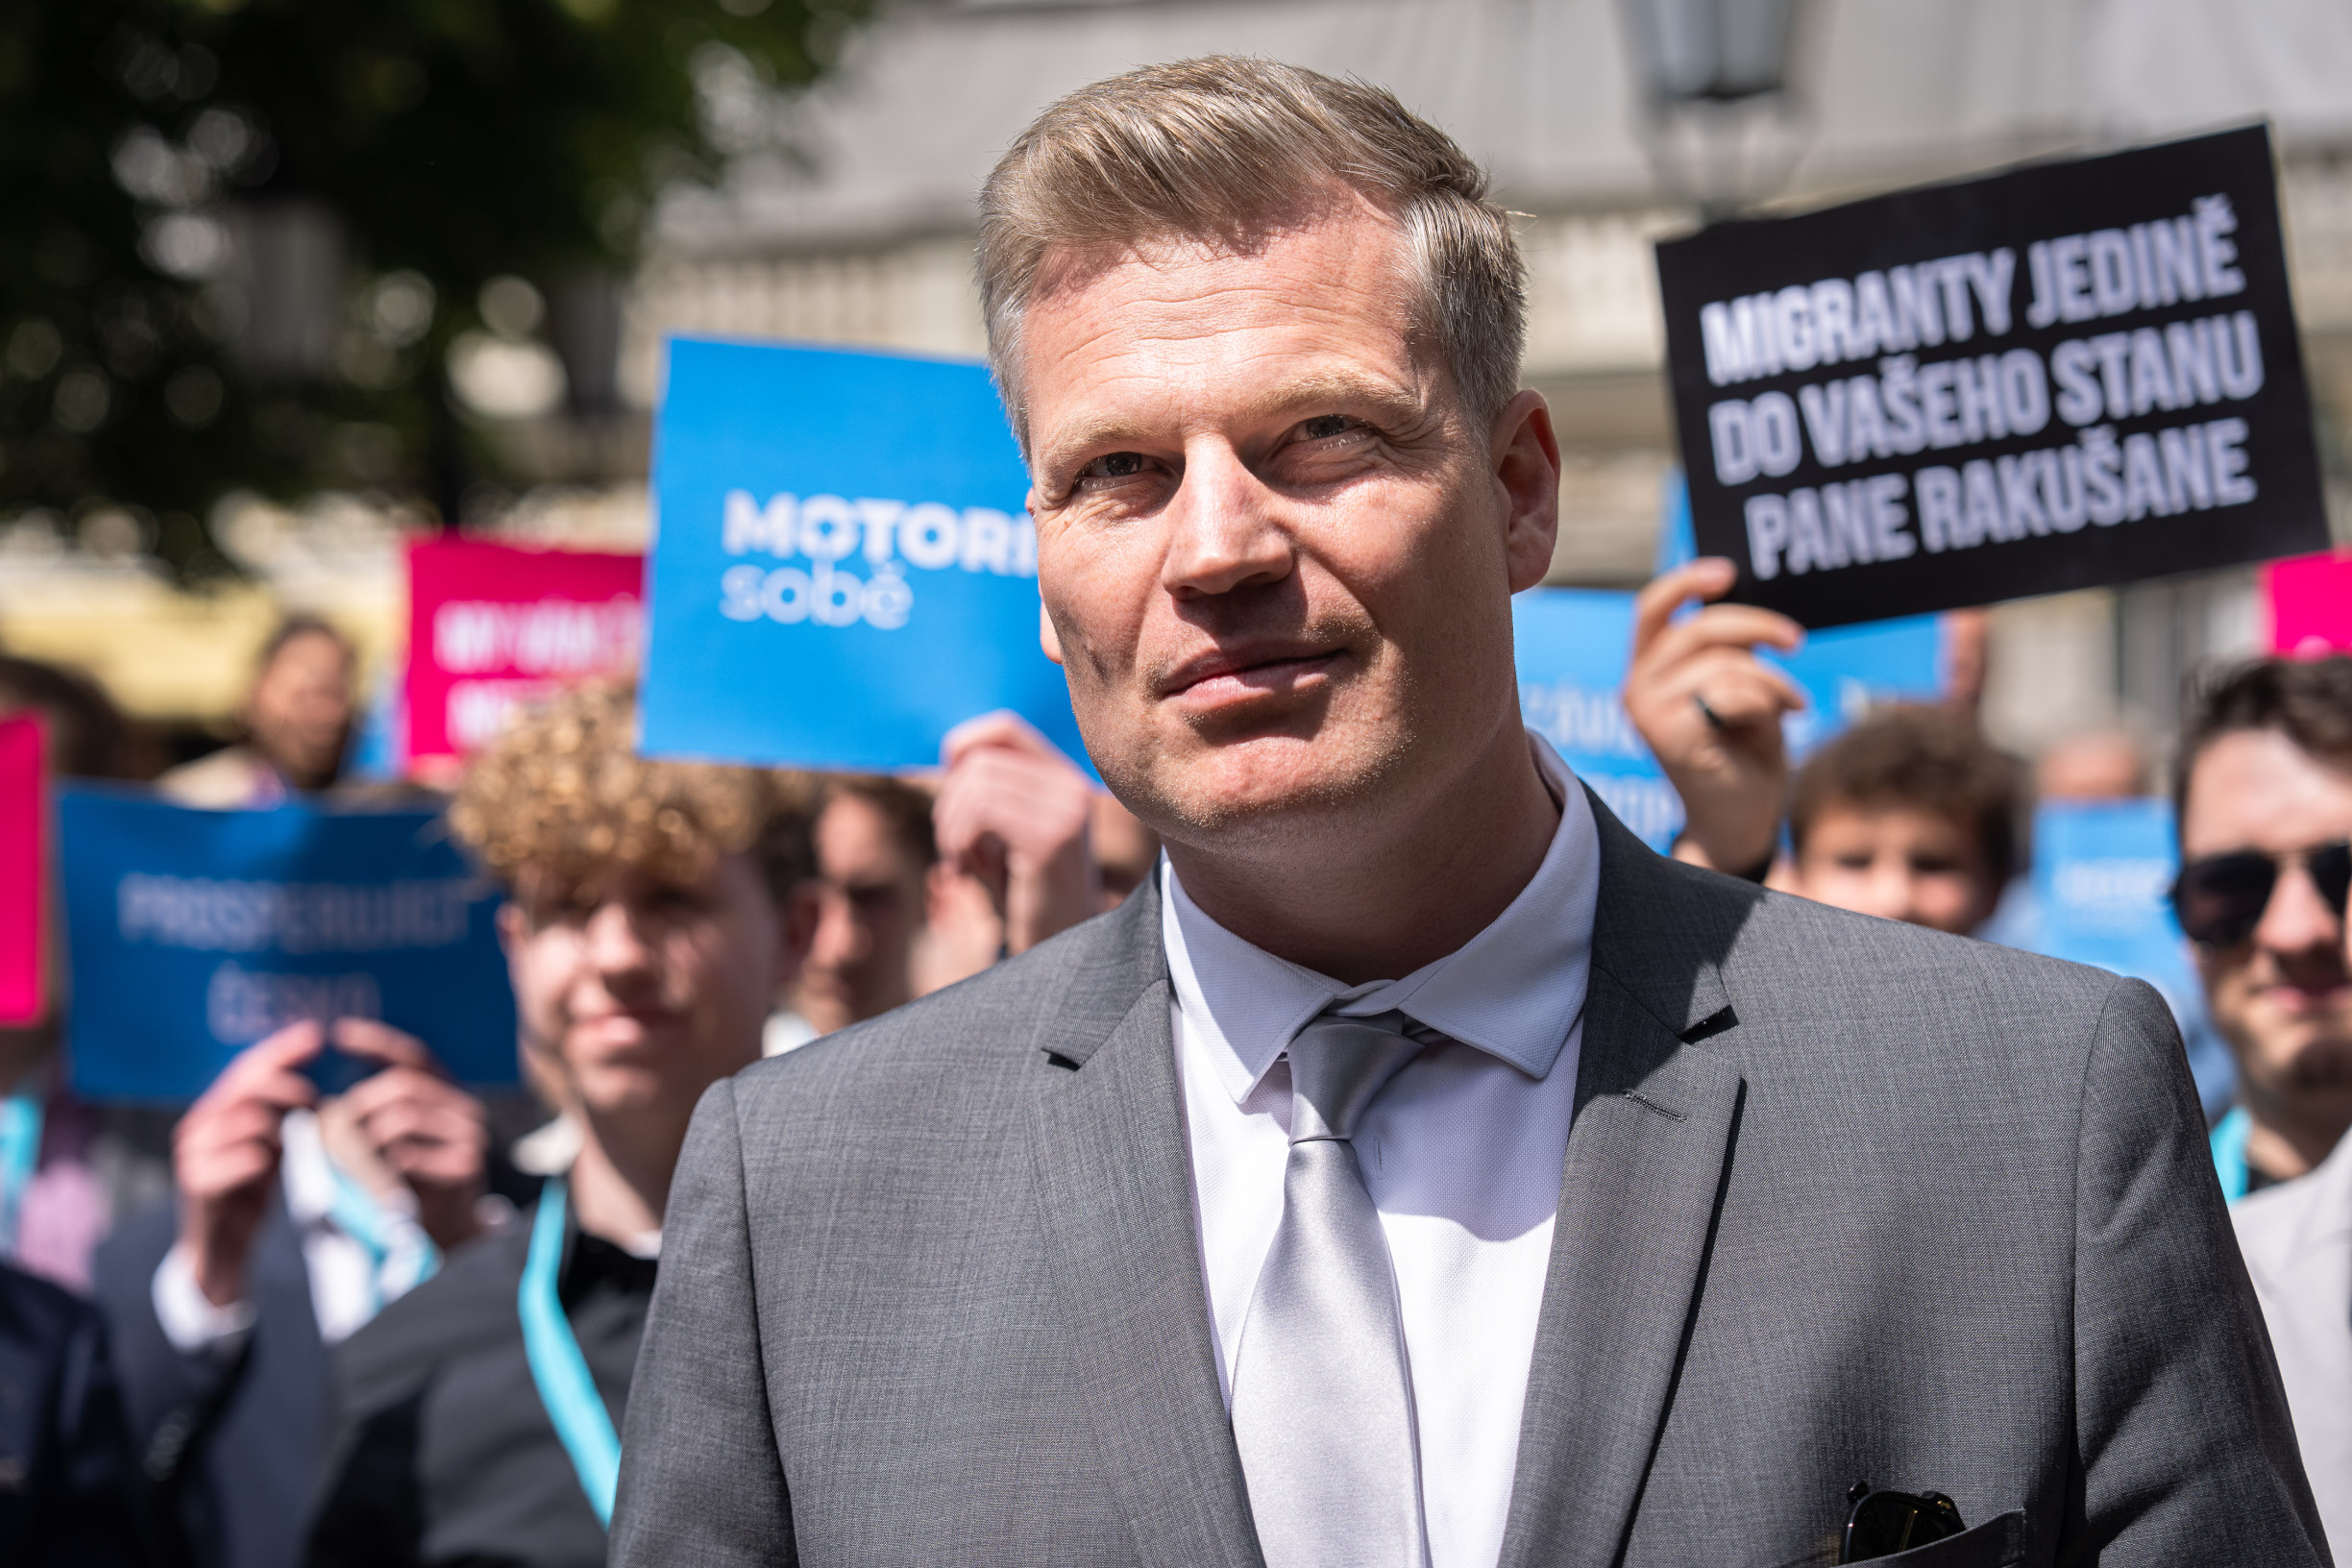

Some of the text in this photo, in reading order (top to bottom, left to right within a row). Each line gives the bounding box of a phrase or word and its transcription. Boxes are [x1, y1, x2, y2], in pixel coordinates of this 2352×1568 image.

[1700, 193, 2246, 387] MIGRANTY JEDINĚ
[1707, 309, 2266, 486] DO VAŠEHO STANU
[1743, 417, 2259, 581] PANE RAKUŠANE
[719, 558, 914, 631] sobě
